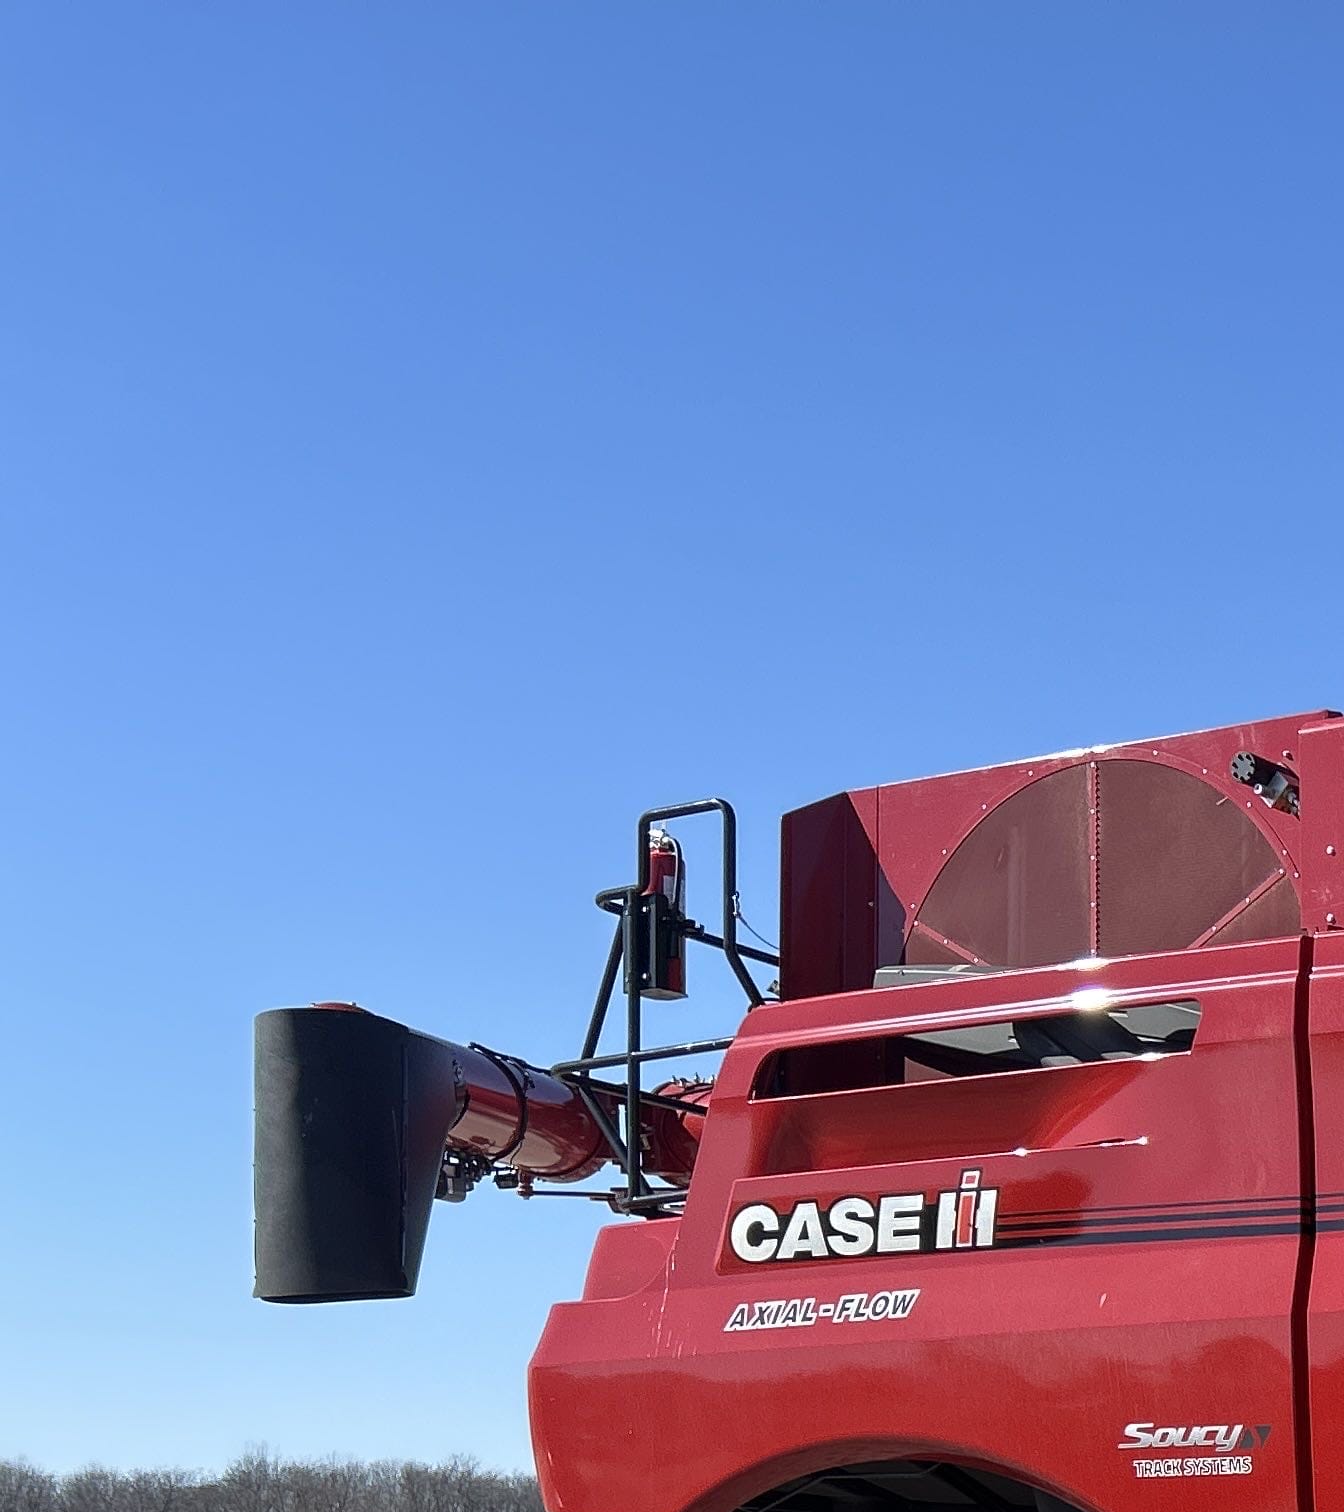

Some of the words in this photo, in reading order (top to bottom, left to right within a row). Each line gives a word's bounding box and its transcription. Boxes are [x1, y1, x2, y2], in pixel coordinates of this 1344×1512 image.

[731, 1194, 923, 1262] CASE
[725, 1289, 919, 1331] AXIAL-FLOW
[1118, 1423, 1243, 1452] Soucy
[1134, 1458, 1182, 1478] TRACK
[1183, 1456, 1252, 1476] SYSTEMS
